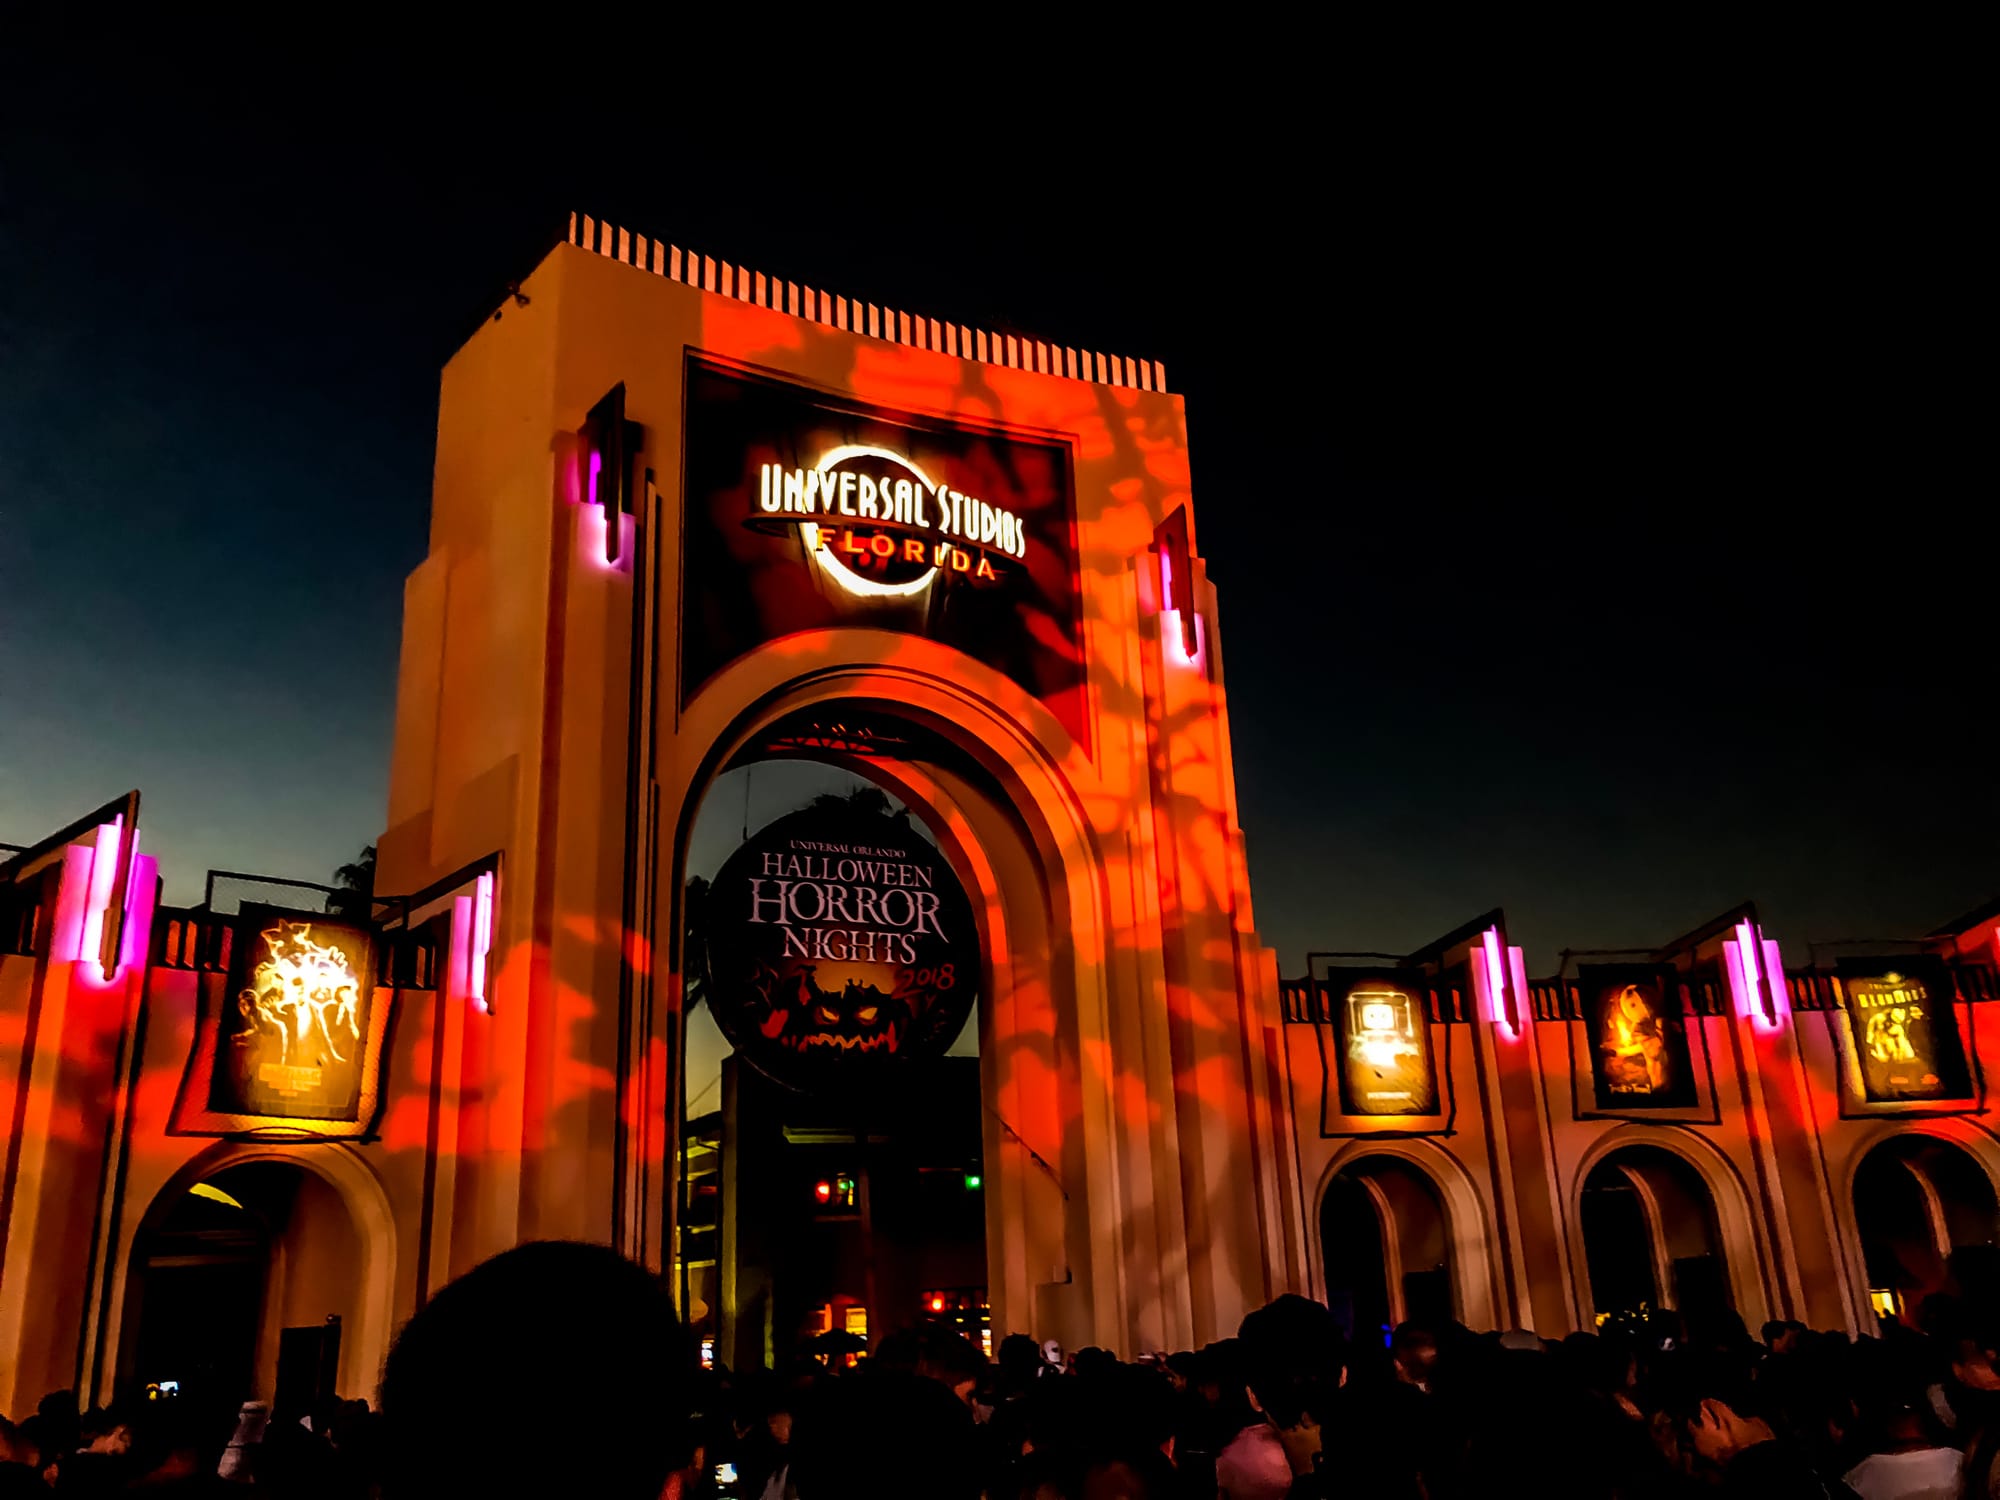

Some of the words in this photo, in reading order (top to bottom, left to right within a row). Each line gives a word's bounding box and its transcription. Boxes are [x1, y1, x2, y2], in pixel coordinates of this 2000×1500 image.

[761, 463, 929, 528] UNIVERSAL
[937, 484, 1025, 558] STUDIOS
[815, 528, 995, 581] FLORIDA
[790, 839, 849, 853] UNIVERSAL
[853, 845, 906, 859] ORLANDO
[762, 852, 932, 888] HALLOWEEN
[747, 877, 949, 943] HORROR
[781, 926, 916, 964] NIGHTS
[895, 962, 956, 997] 2018
